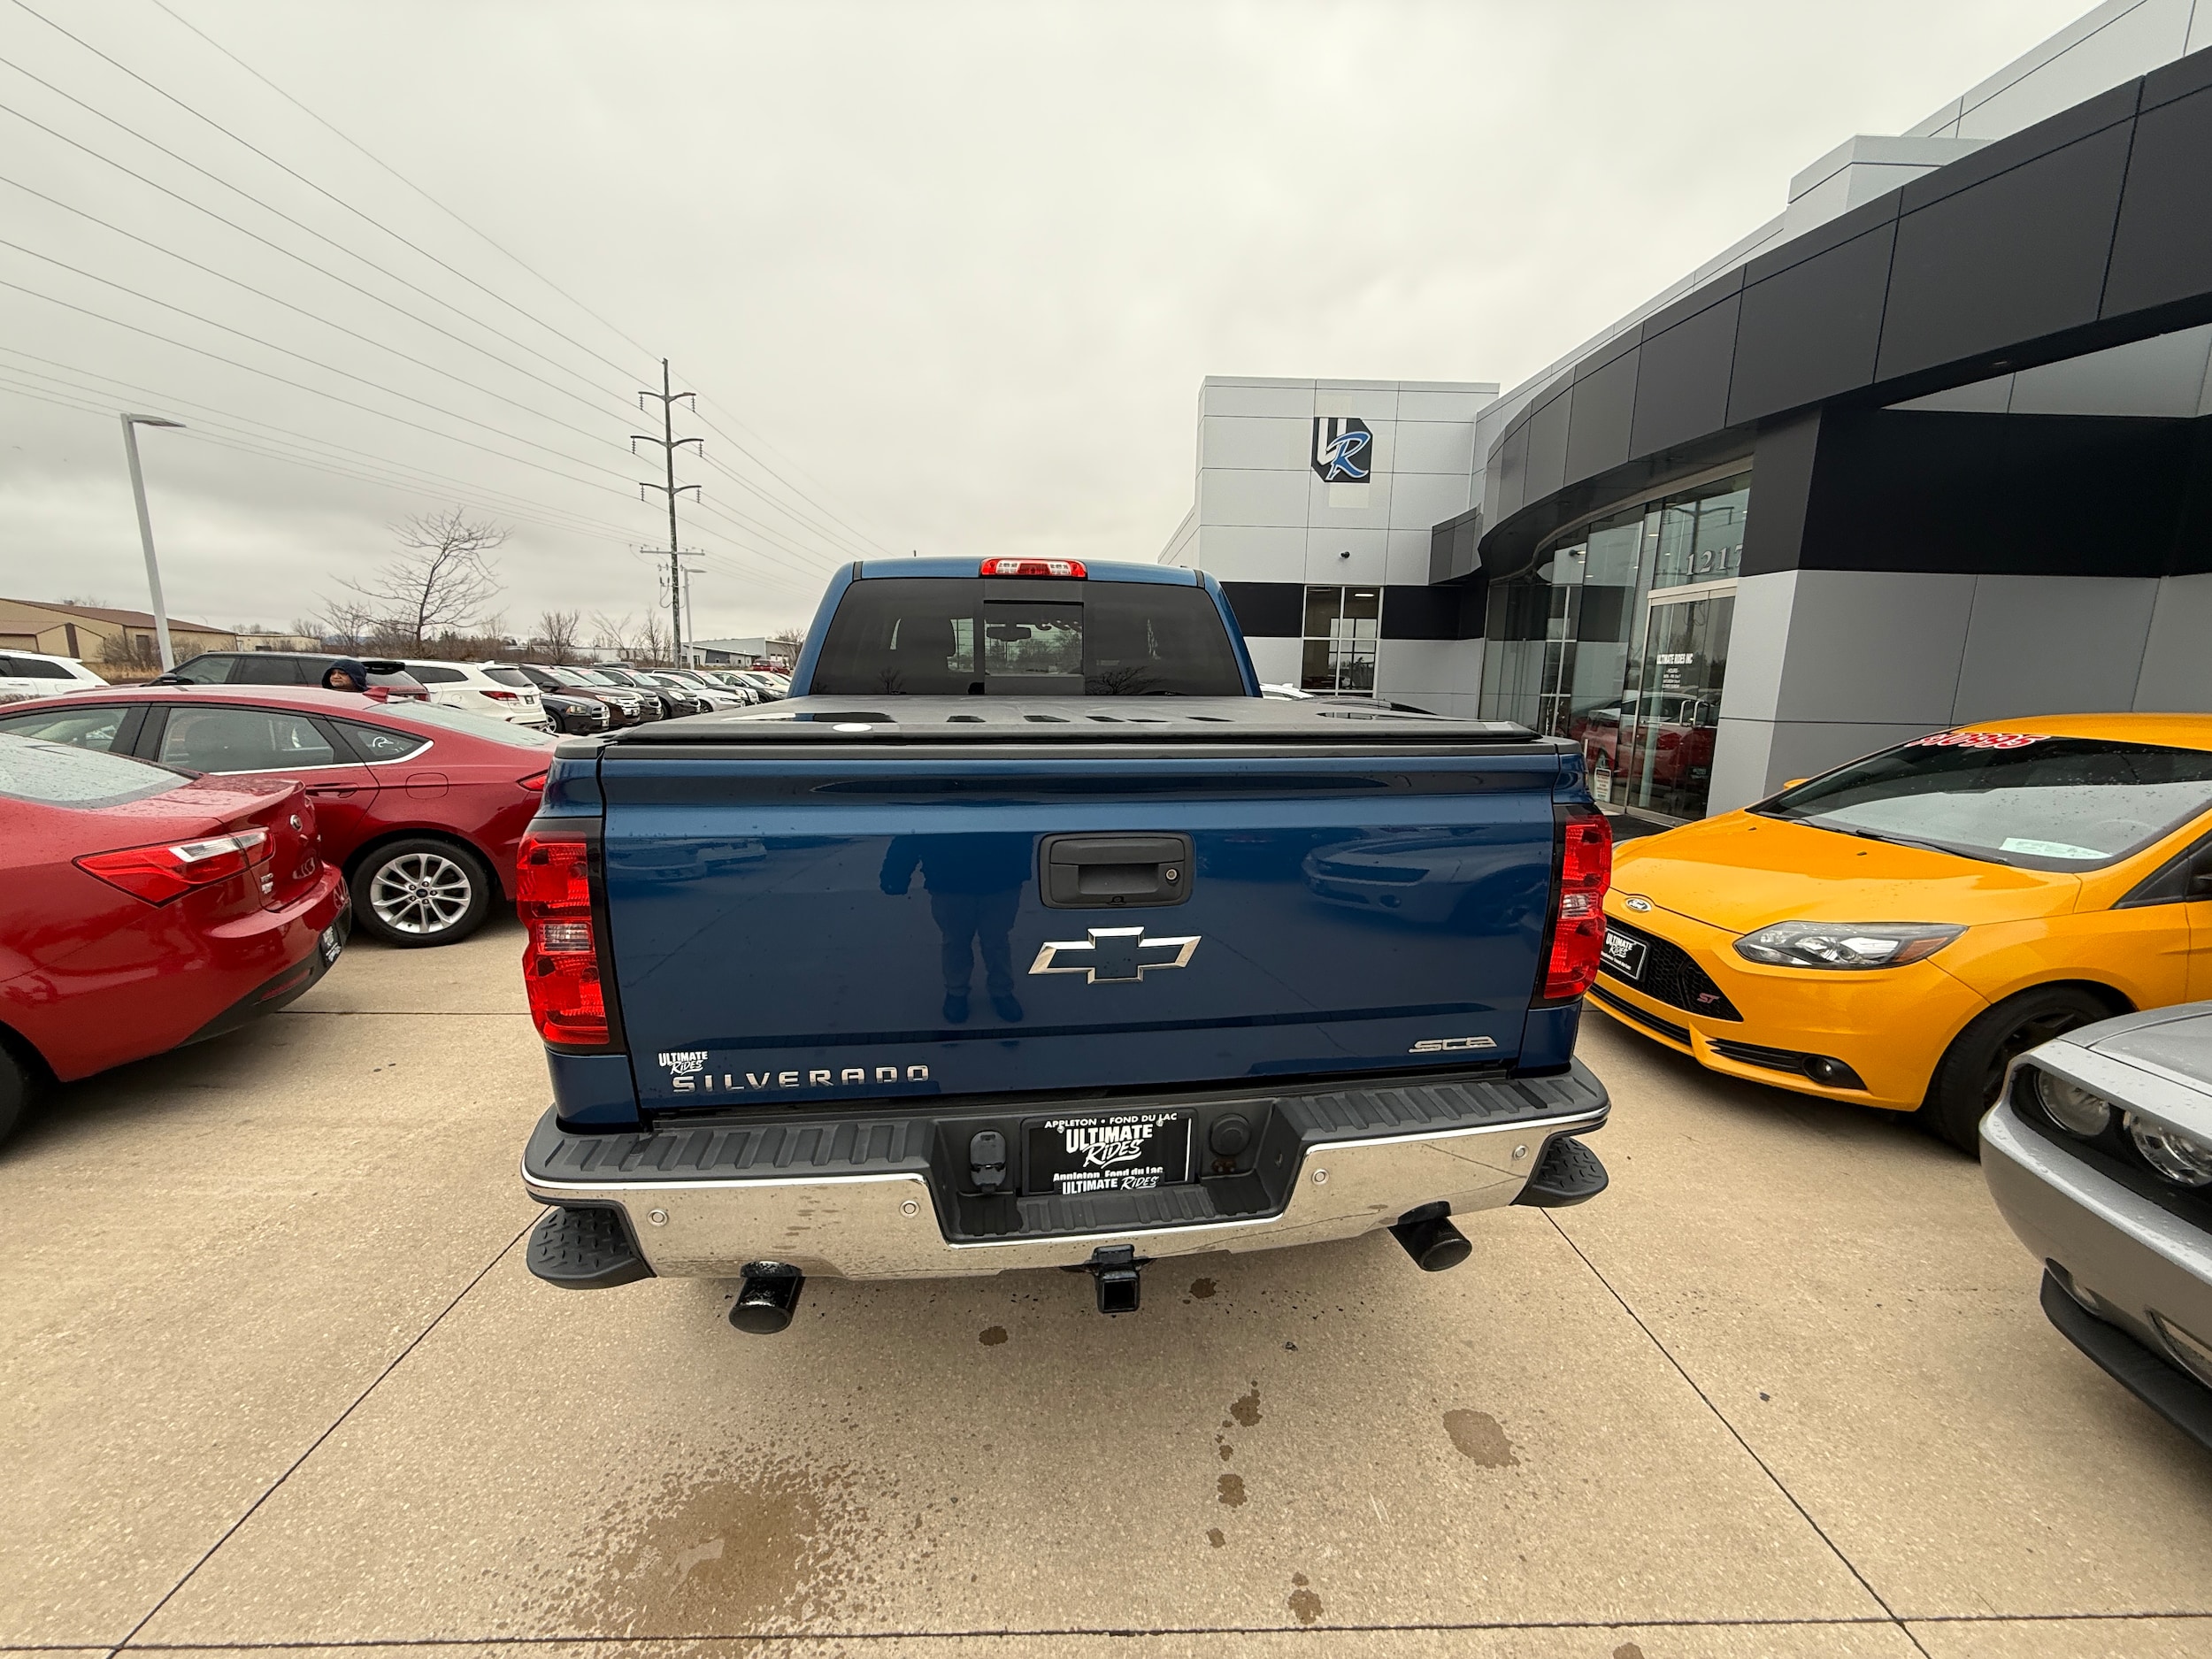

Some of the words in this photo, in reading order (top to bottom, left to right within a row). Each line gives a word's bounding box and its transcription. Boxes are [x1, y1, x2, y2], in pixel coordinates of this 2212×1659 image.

[1606, 933, 1633, 951] ULTIMATE
[1697, 992, 1720, 1003] ST
[658, 1051, 708, 1067] ULTIMATE
[672, 1064, 929, 1093] SILVERADO
[1044, 1118, 1097, 1129] APPLETON
[1110, 1116, 1139, 1125] FOND
[1159, 1113, 1178, 1122] LAC
[1066, 1124, 1153, 1154] ULTIMATE
[1131, 1167, 1145, 1176] du
[1063, 1178, 1118, 1194] ULTIMATE
